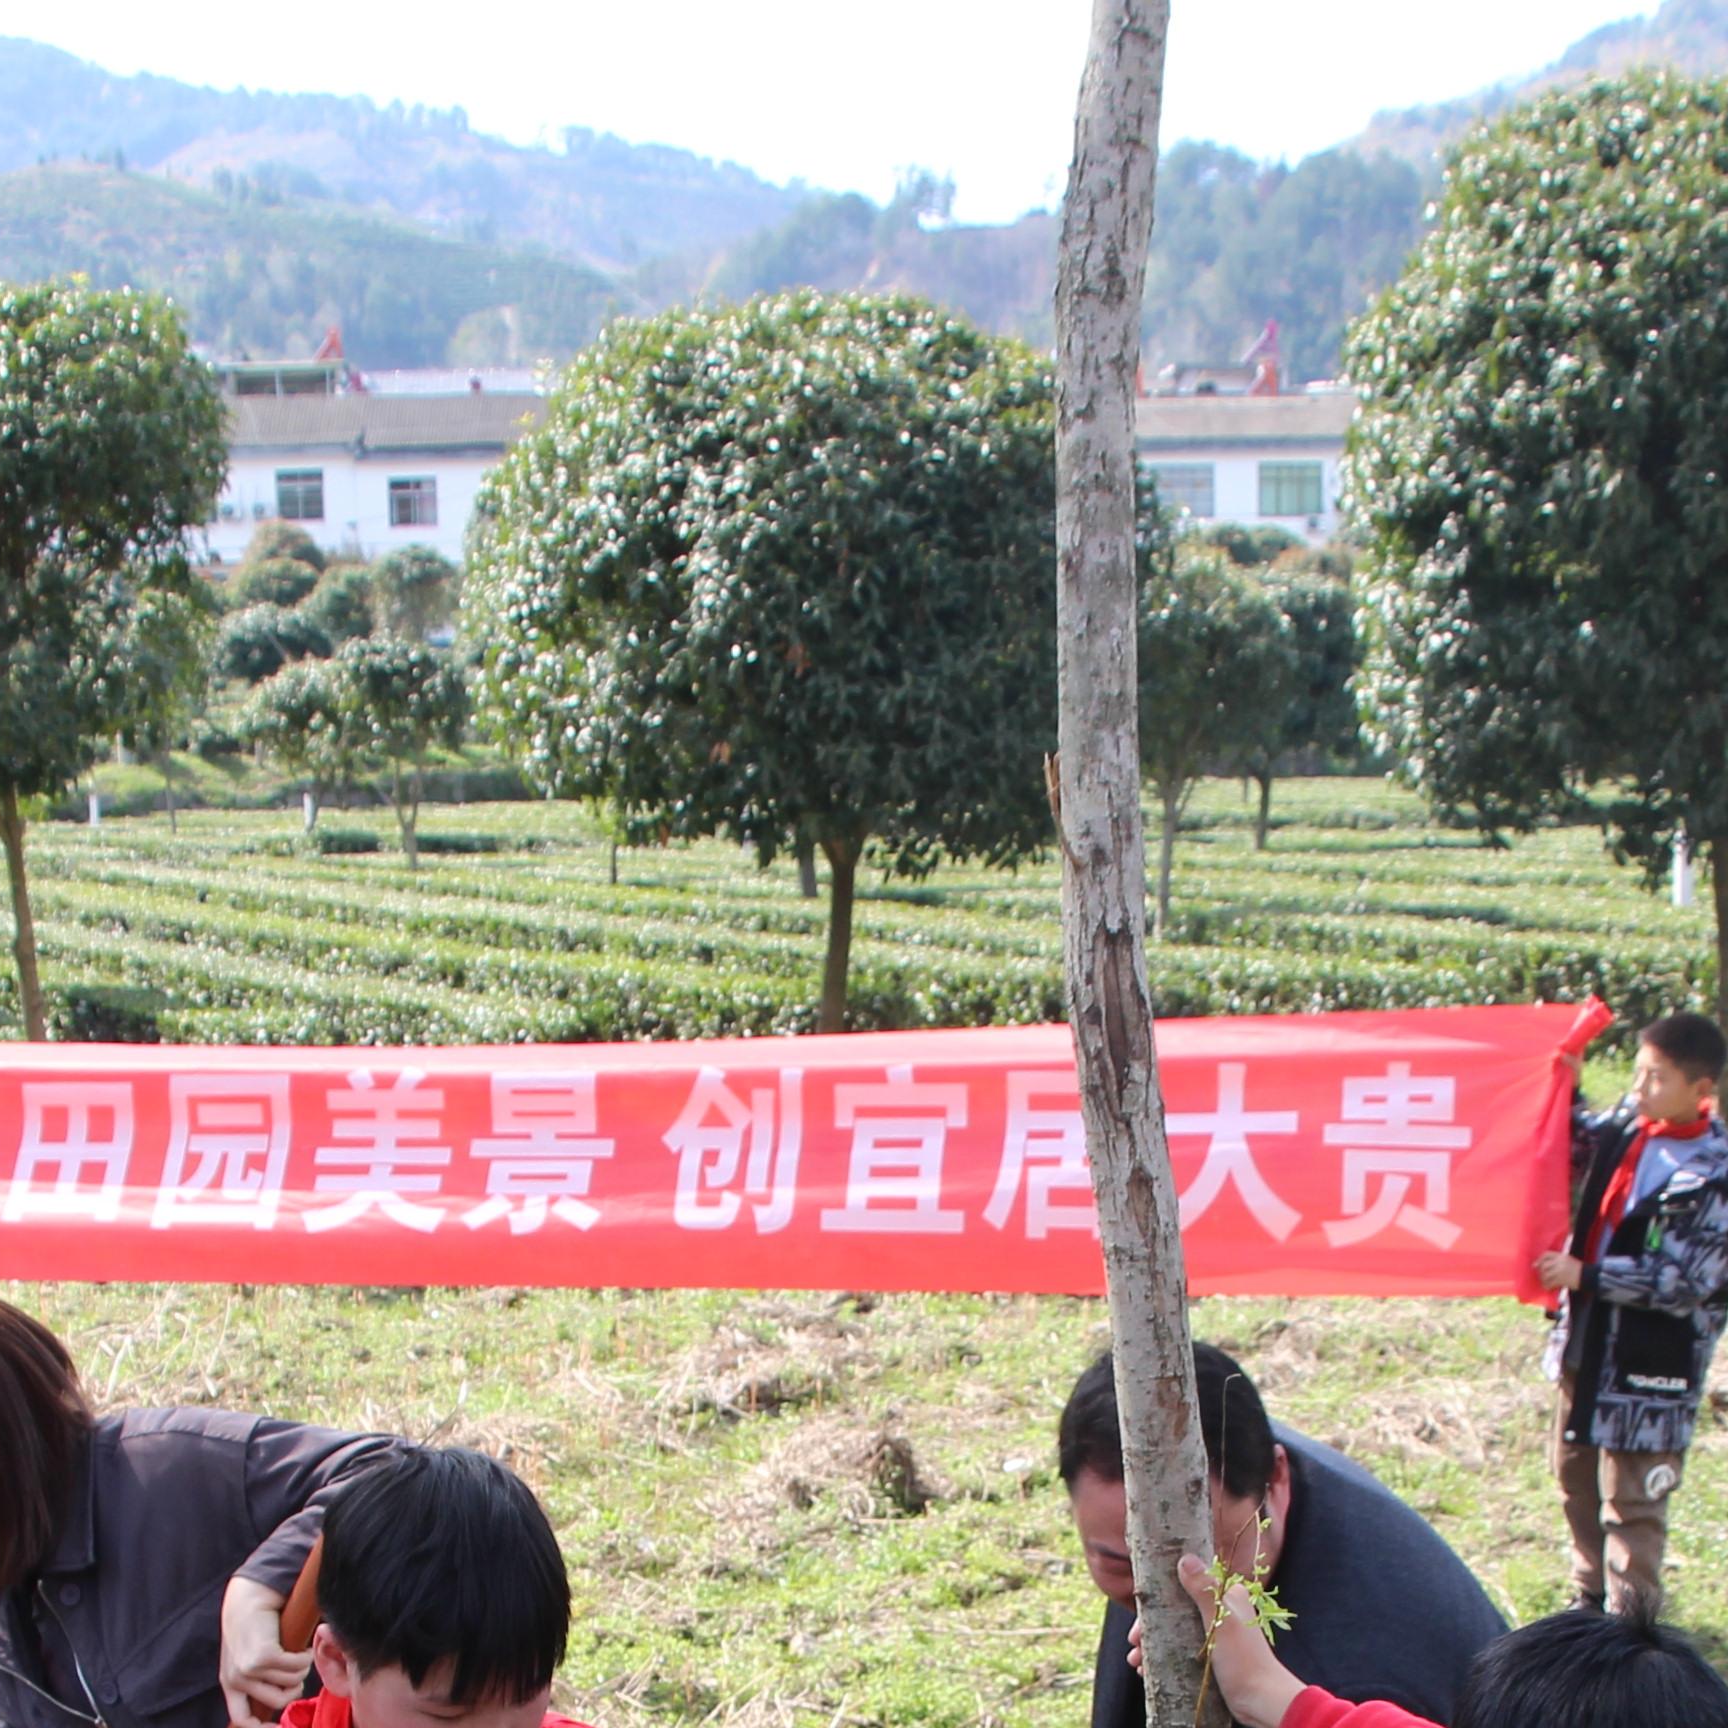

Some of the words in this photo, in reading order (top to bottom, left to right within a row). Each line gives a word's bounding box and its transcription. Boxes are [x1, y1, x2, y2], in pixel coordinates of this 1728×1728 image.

[661, 1062, 1472, 1250] 创宜居大贵
